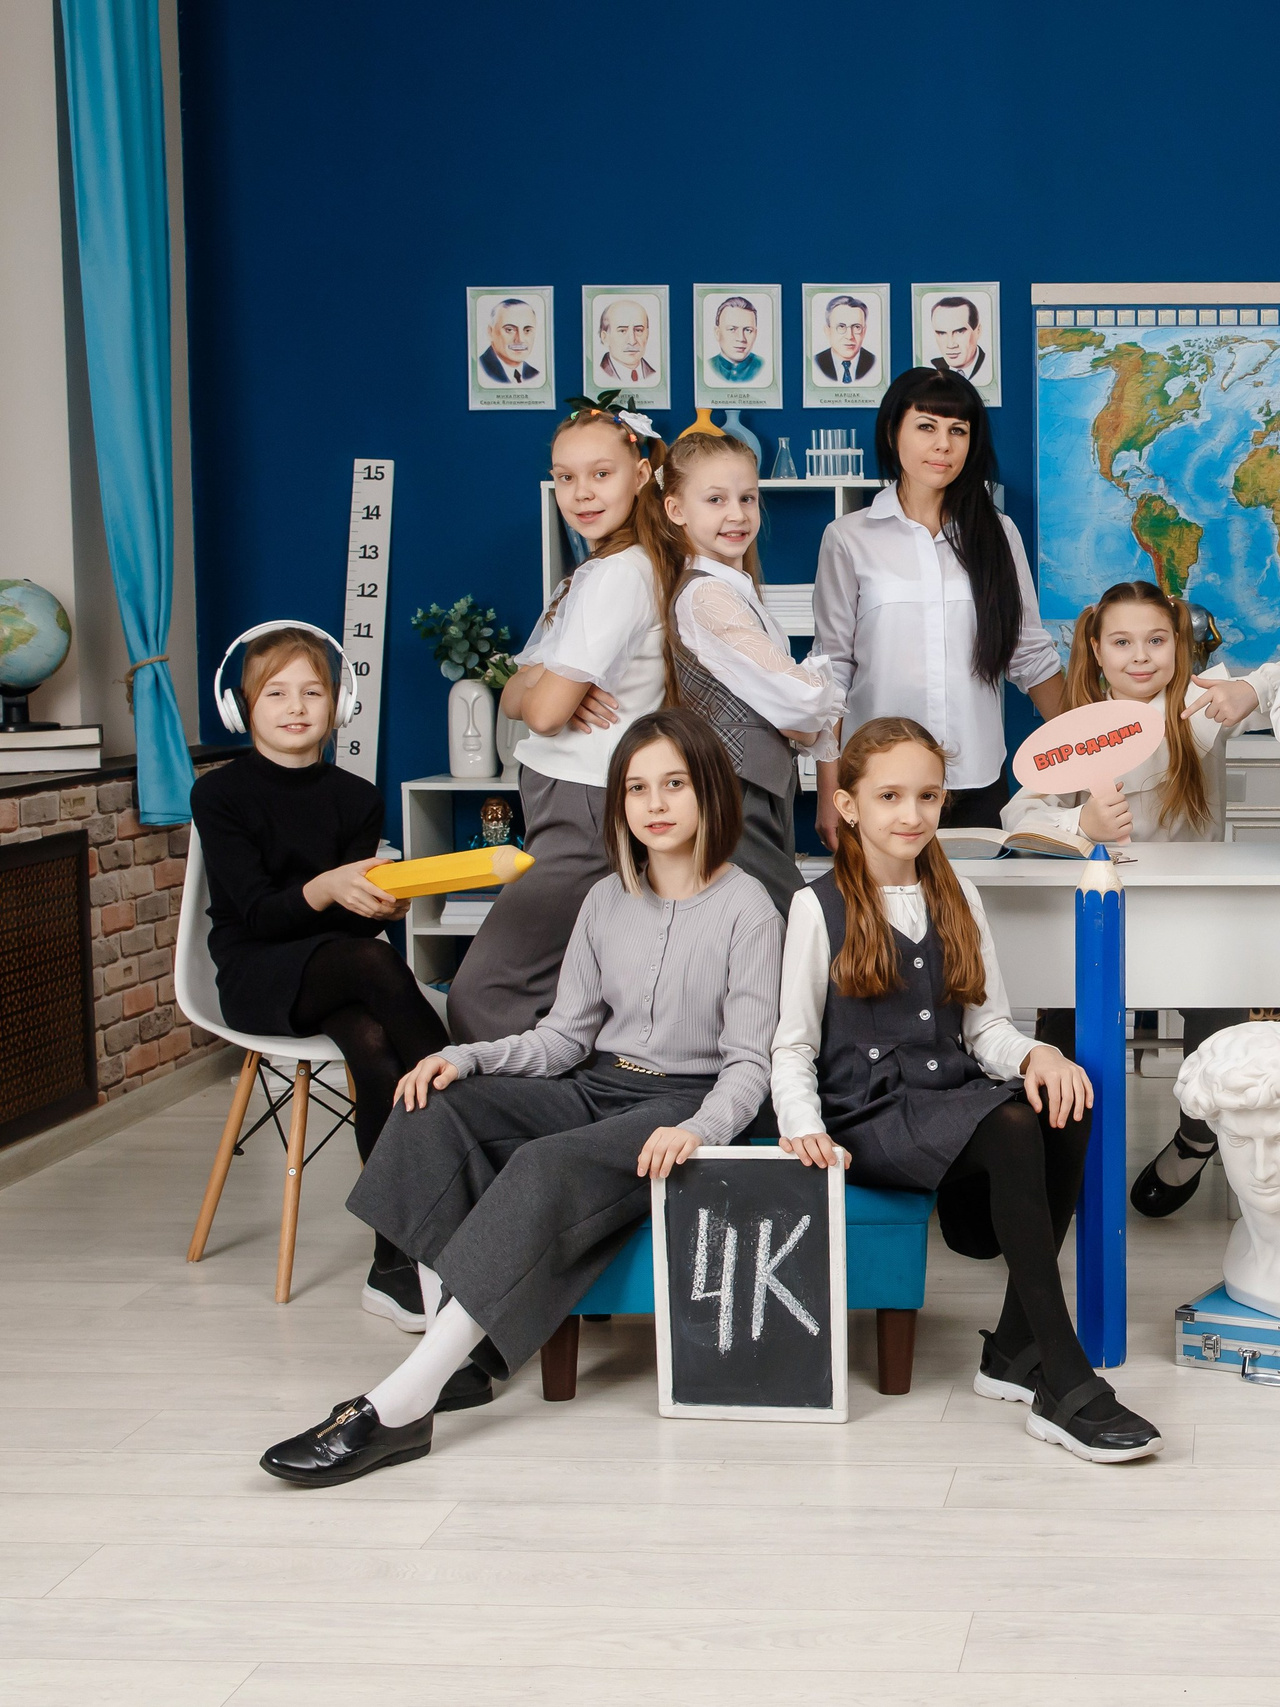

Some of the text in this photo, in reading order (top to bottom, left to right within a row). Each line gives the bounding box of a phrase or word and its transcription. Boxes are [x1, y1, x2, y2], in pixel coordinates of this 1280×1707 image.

[362, 465, 385, 481] 15
[361, 504, 382, 520] 14
[358, 544, 379, 560] 13
[356, 582, 379, 598] 12
[353, 622, 374, 639] 11
[352, 661, 370, 676] 10
[353, 701, 363, 716] 9
[349, 740, 361, 755] 8
[1033, 721, 1143, 771] ВПР сдадим
